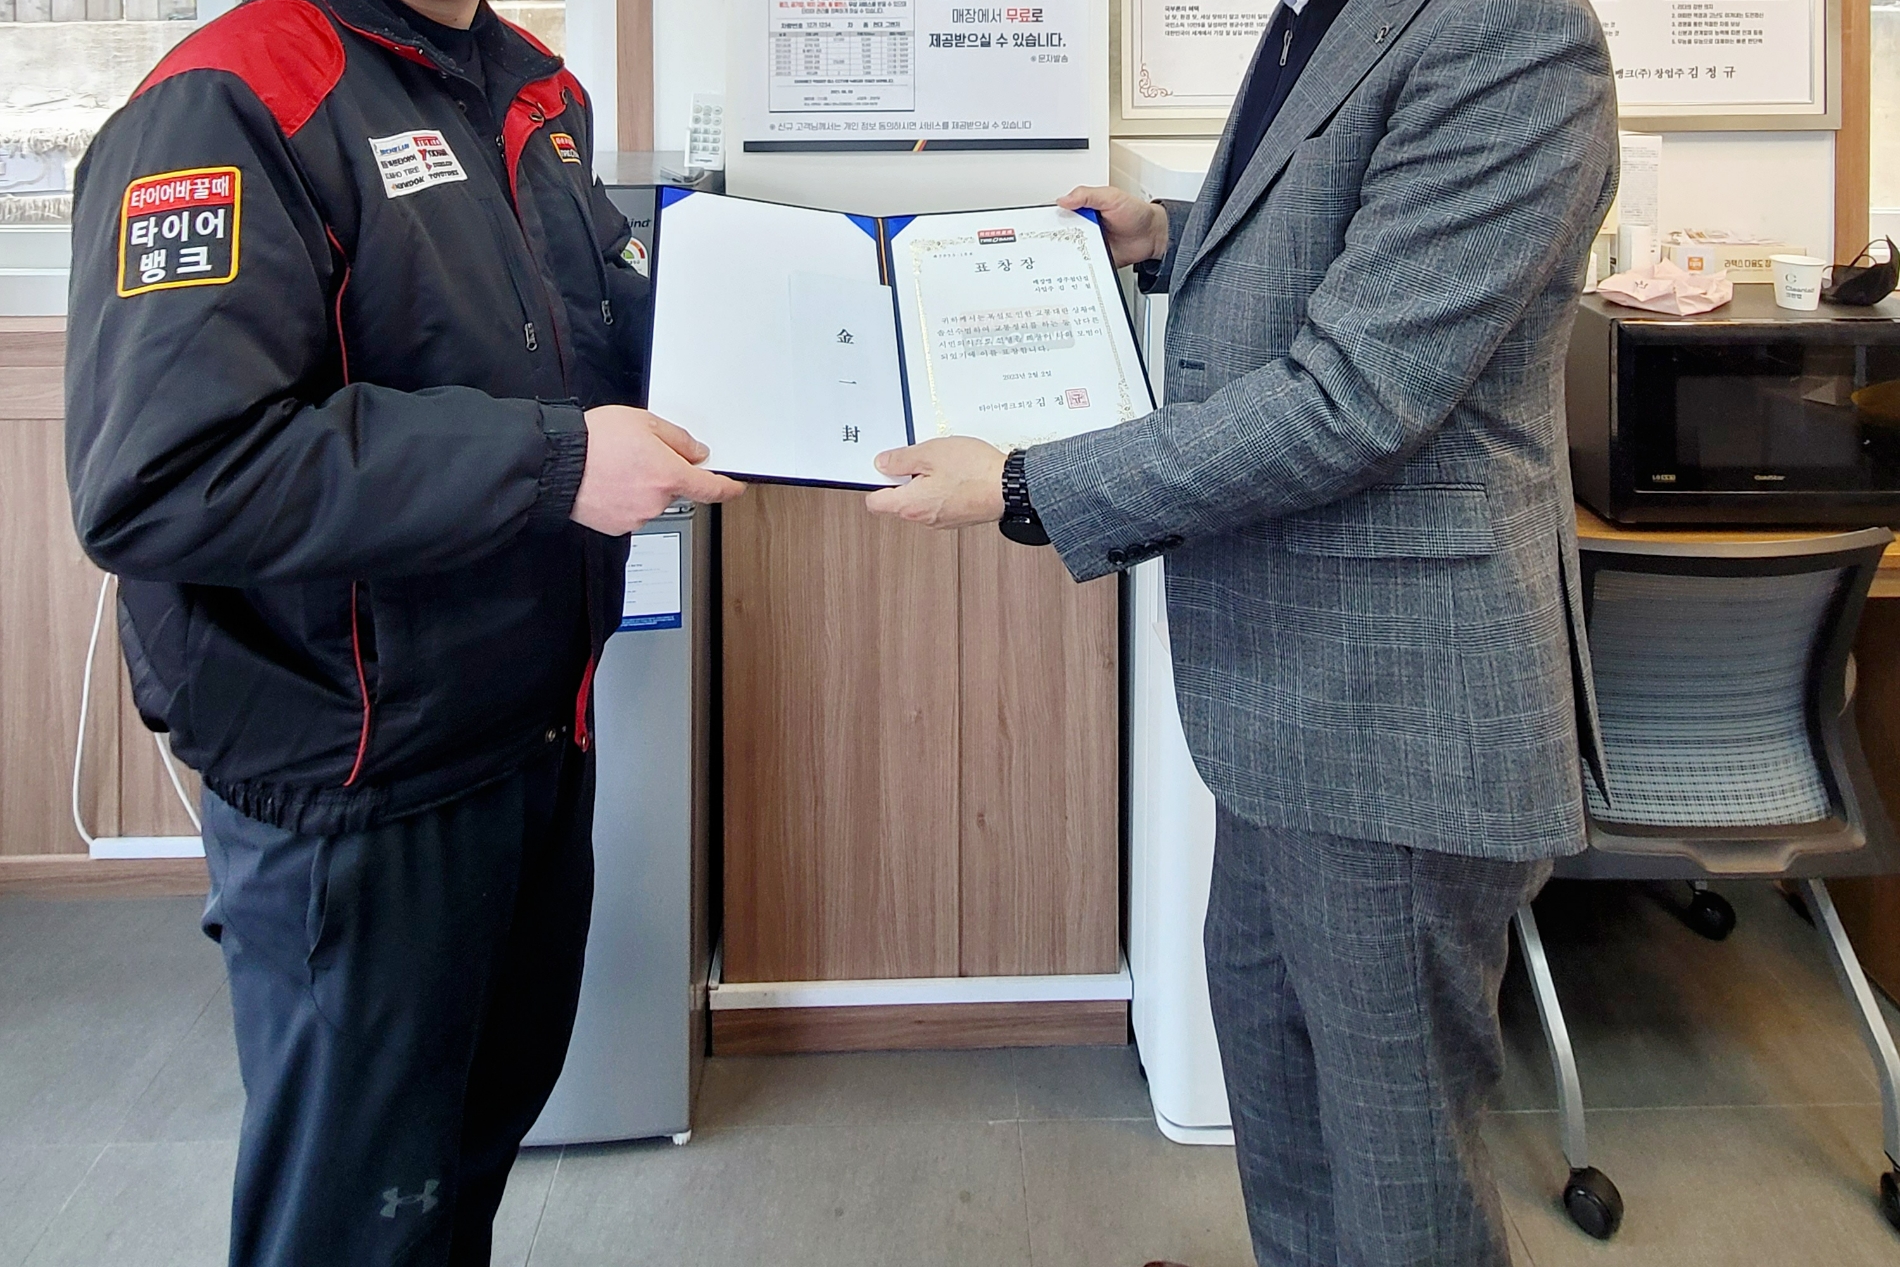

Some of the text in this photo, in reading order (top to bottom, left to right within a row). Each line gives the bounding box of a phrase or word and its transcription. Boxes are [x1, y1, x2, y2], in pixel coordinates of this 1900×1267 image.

[952, 8, 1044, 23] 매장에서 무료로
[929, 33, 1066, 48] 제공받으실 수 있습니다.
[778, 121, 1032, 131] 신규 고객님께서는 개인 정보 동의하시면 서비스를 제공받으실 수 있습니다
[130, 208, 226, 247] 타이어
